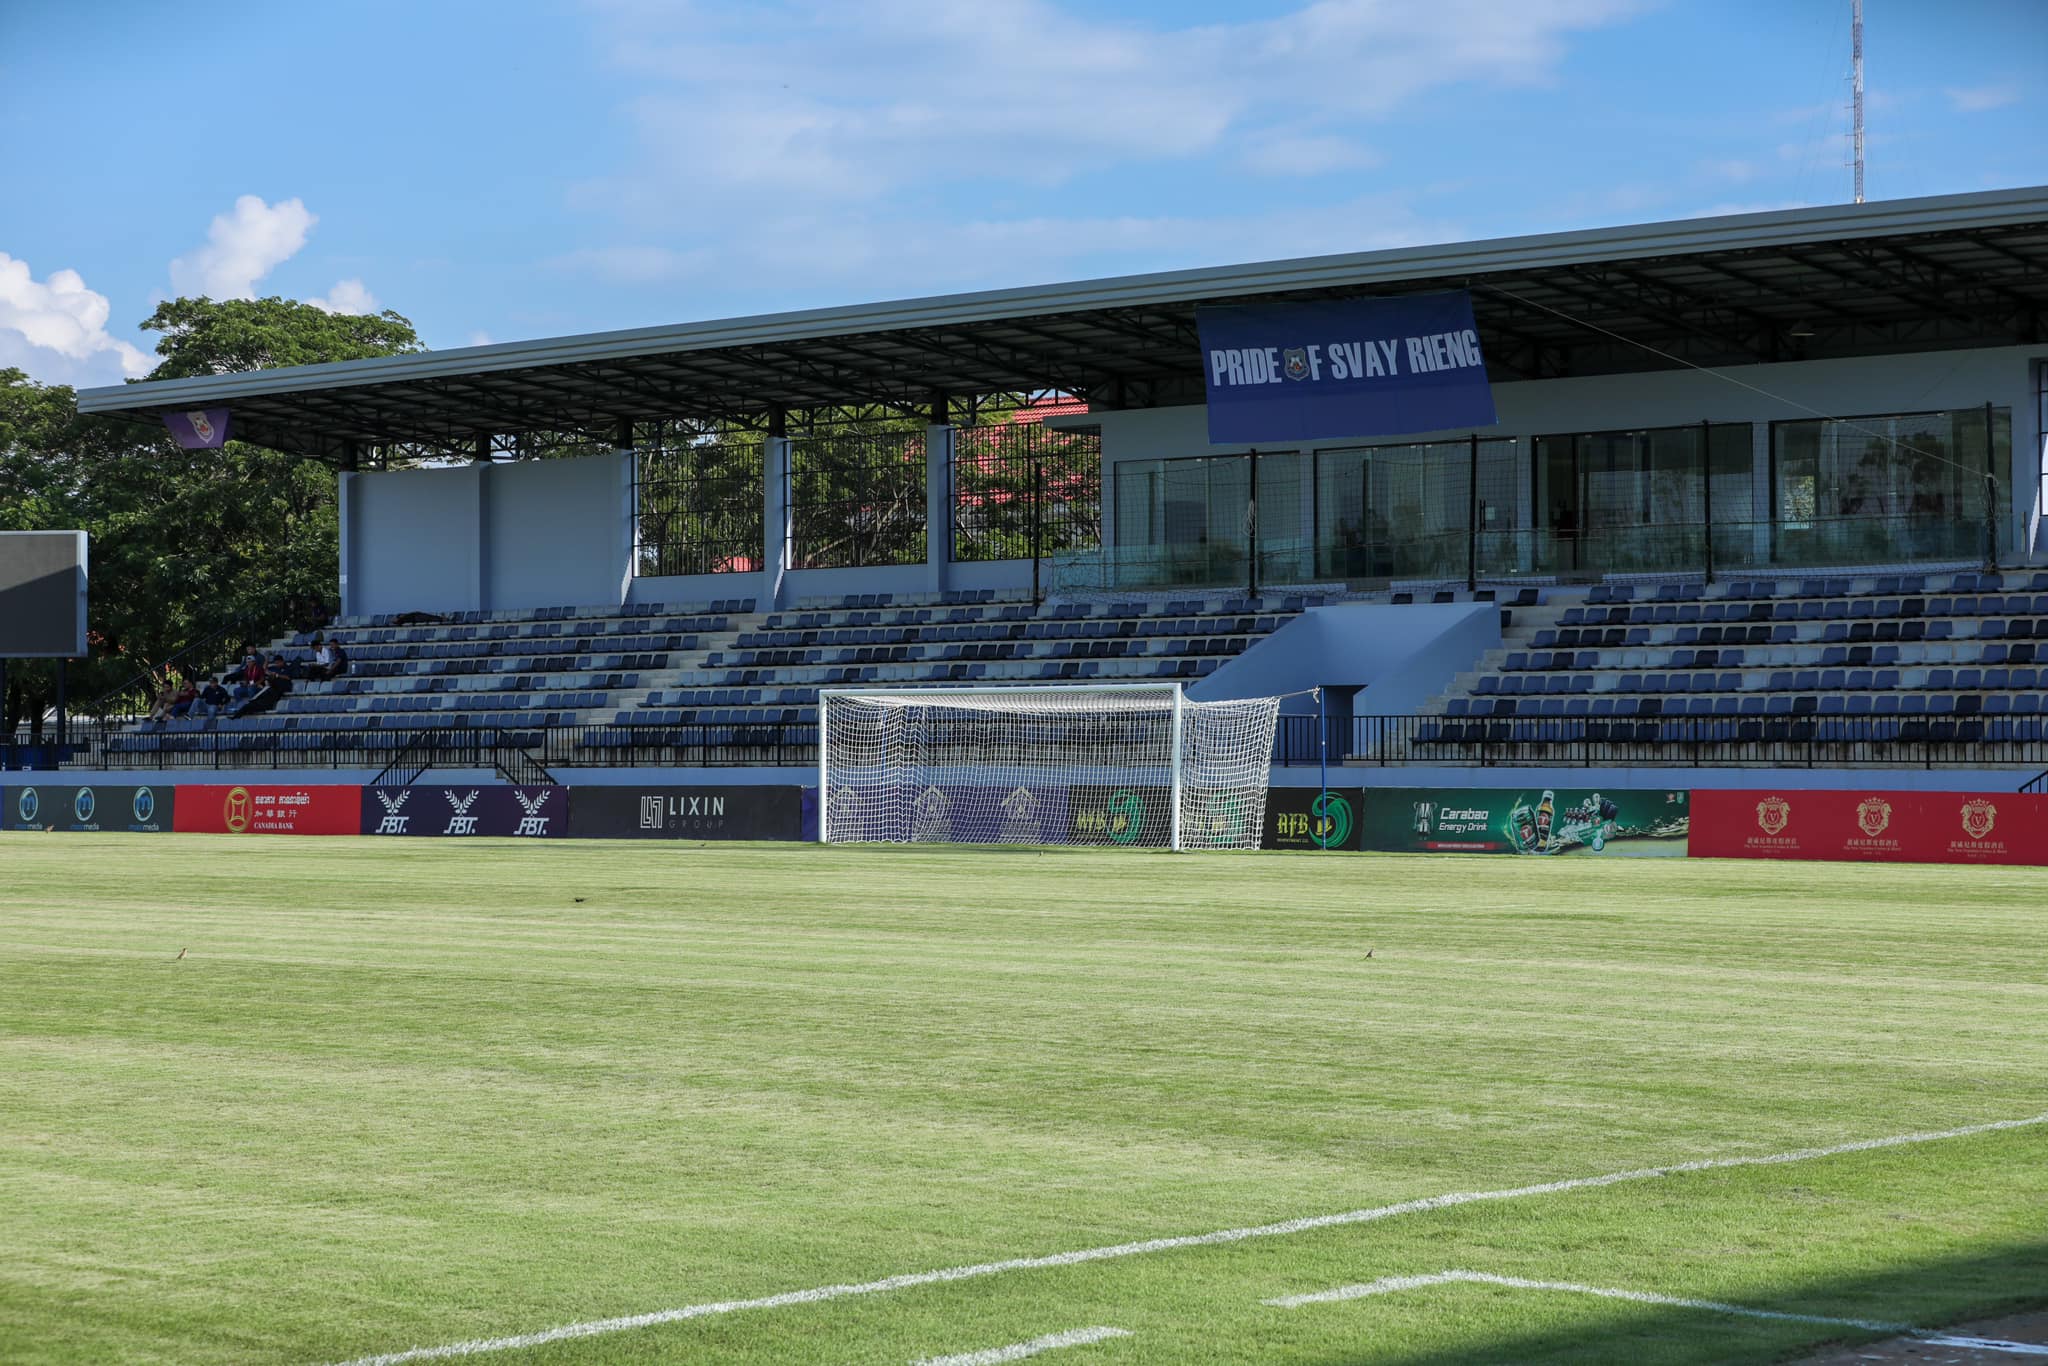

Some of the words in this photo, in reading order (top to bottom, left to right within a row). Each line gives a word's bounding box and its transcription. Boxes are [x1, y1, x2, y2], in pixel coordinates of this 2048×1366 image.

[1210, 347, 1282, 386] PRIDE
[1328, 339, 1398, 380] SVAY
[1405, 329, 1482, 374] RIENG
[669, 796, 724, 816] LIXIN
[1440, 807, 1489, 820] Carabao
[668, 820, 724, 829] GROUP
[1439, 822, 1467, 833] Energy
[1467, 822, 1488, 831] Drink
